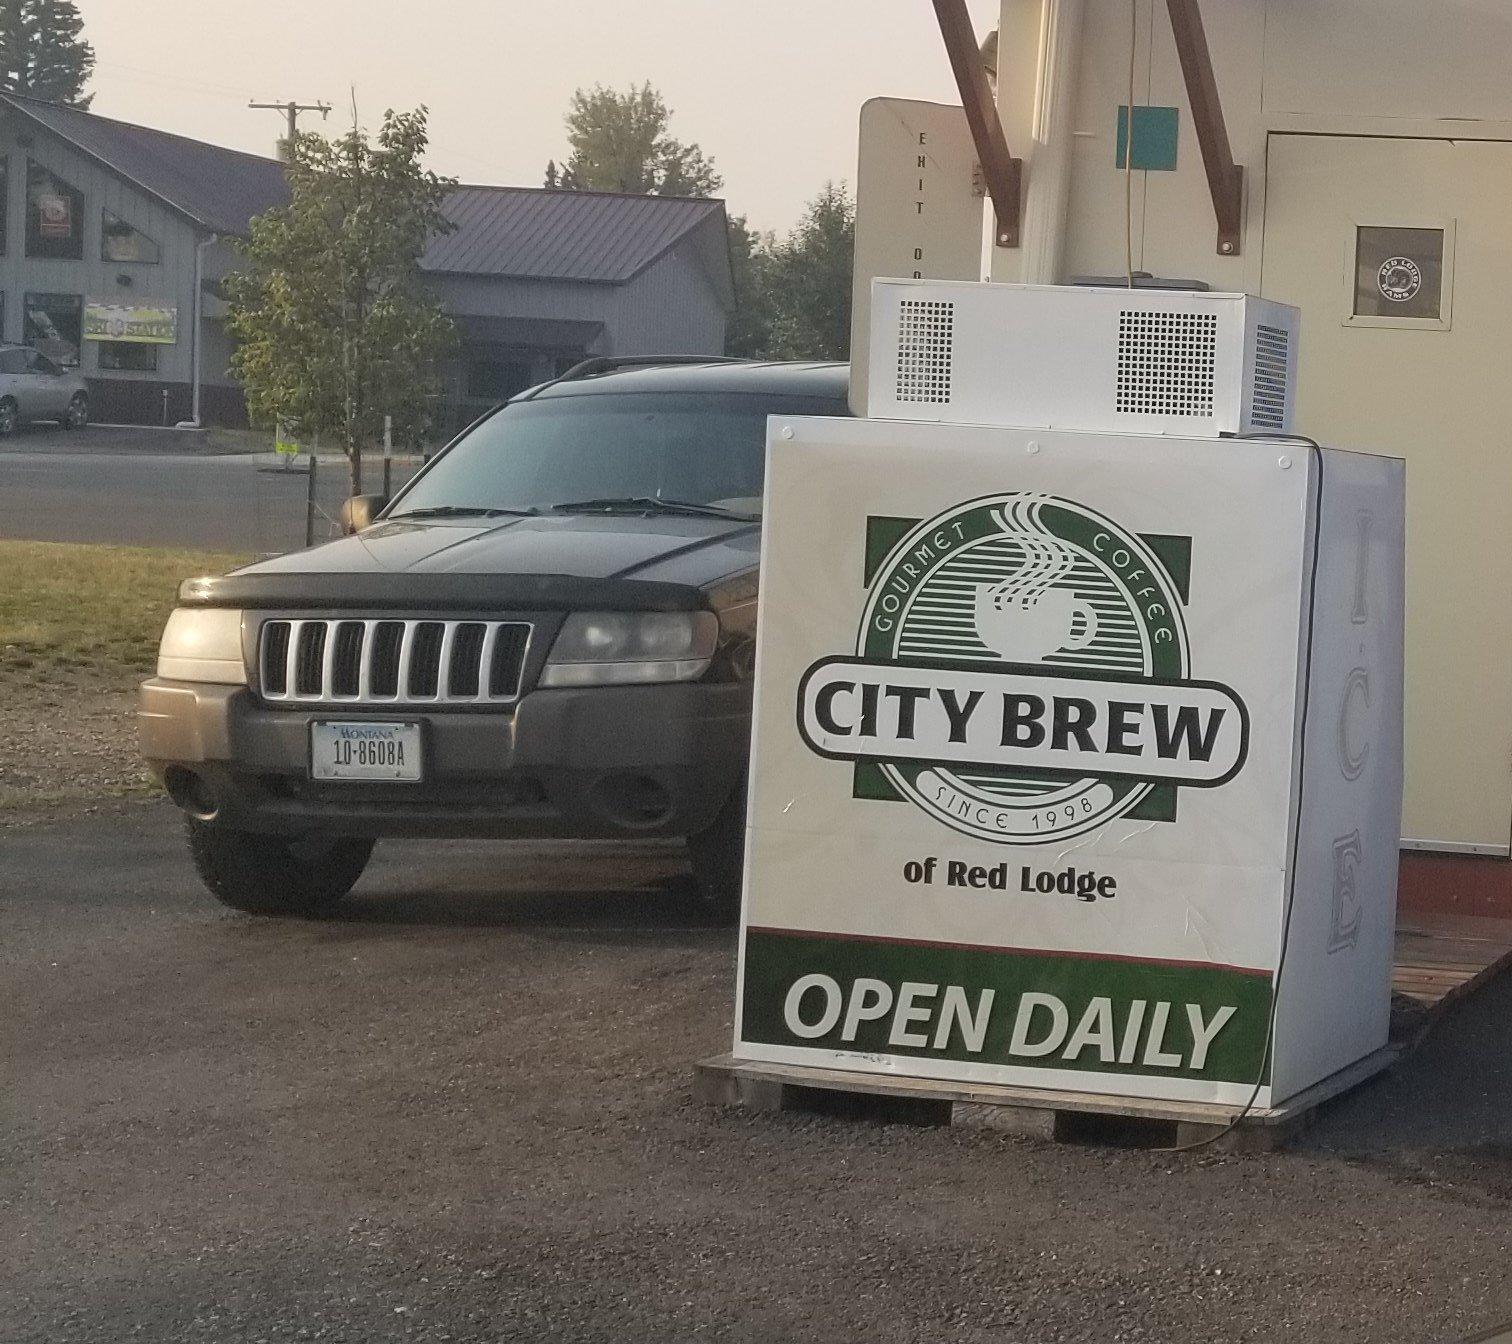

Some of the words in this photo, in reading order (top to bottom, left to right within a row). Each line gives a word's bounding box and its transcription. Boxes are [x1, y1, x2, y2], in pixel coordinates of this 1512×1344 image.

[875, 521, 966, 632] GOURMET
[1093, 532, 1172, 644] COFFEE
[814, 680, 985, 743] CITY
[1000, 692, 1226, 763] BREW
[936, 786, 1008, 829] SINCE
[1031, 797, 1092, 829] 1998
[903, 856, 938, 884] of
[947, 860, 1008, 890] Red
[1021, 866, 1117, 902] Lodge
[783, 973, 996, 1053] OPEN
[1008, 991, 1237, 1070] DAILY
